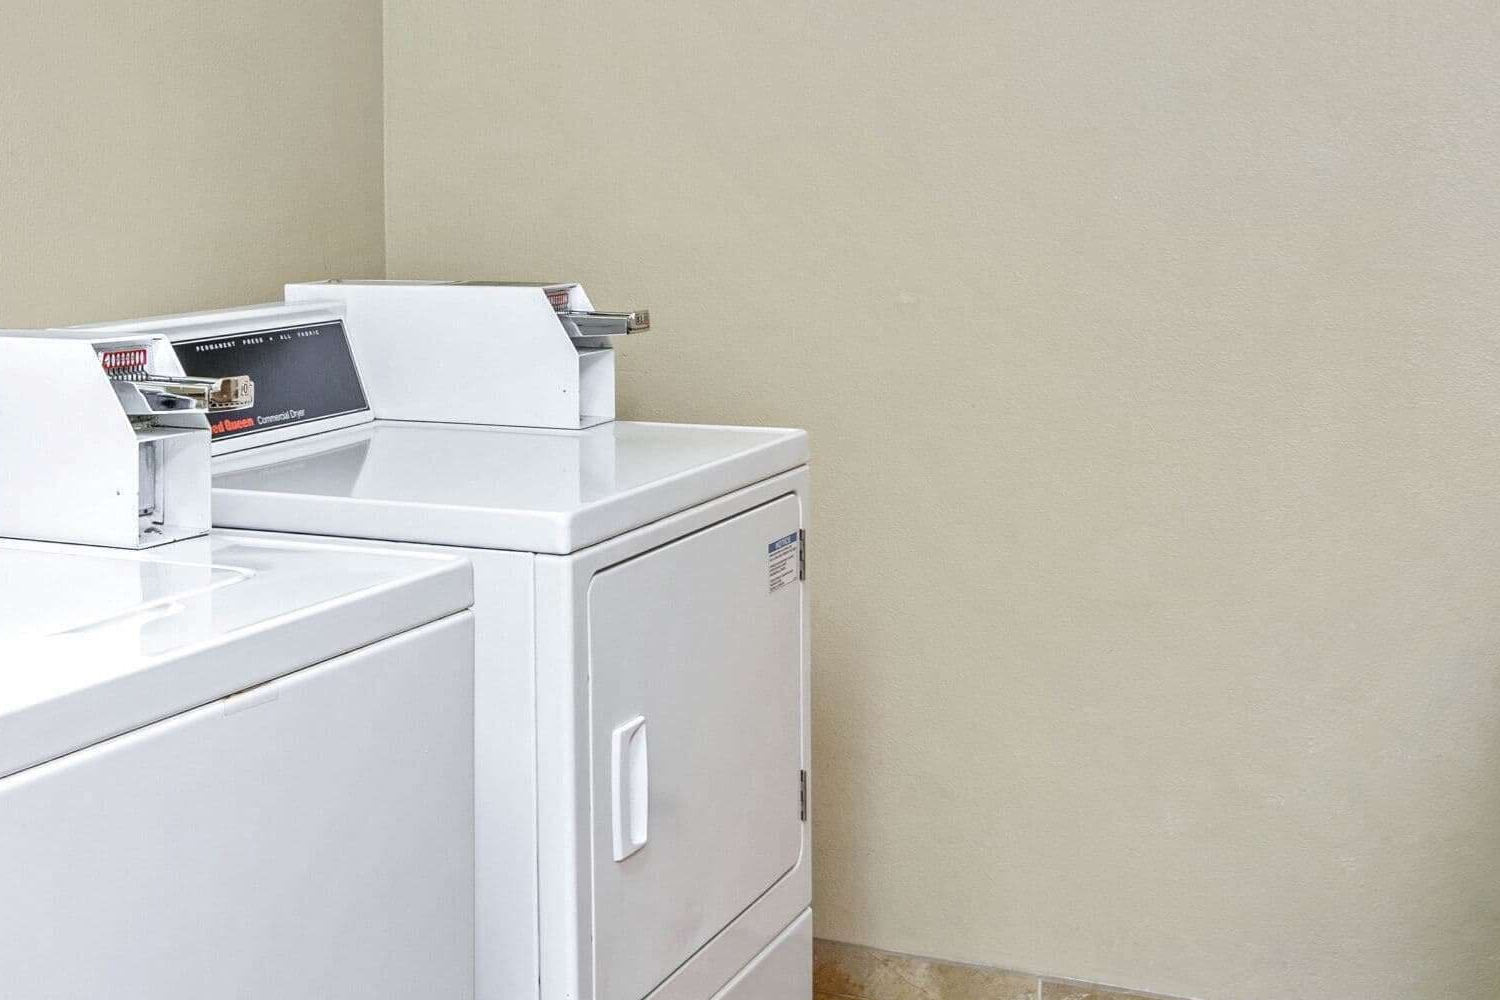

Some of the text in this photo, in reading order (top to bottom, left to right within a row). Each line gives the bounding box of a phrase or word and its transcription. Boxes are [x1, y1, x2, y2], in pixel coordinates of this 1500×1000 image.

[224, 418, 255, 431] Queen
[256, 411, 290, 425] Commercial
[290, 409, 305, 419] Dryer
